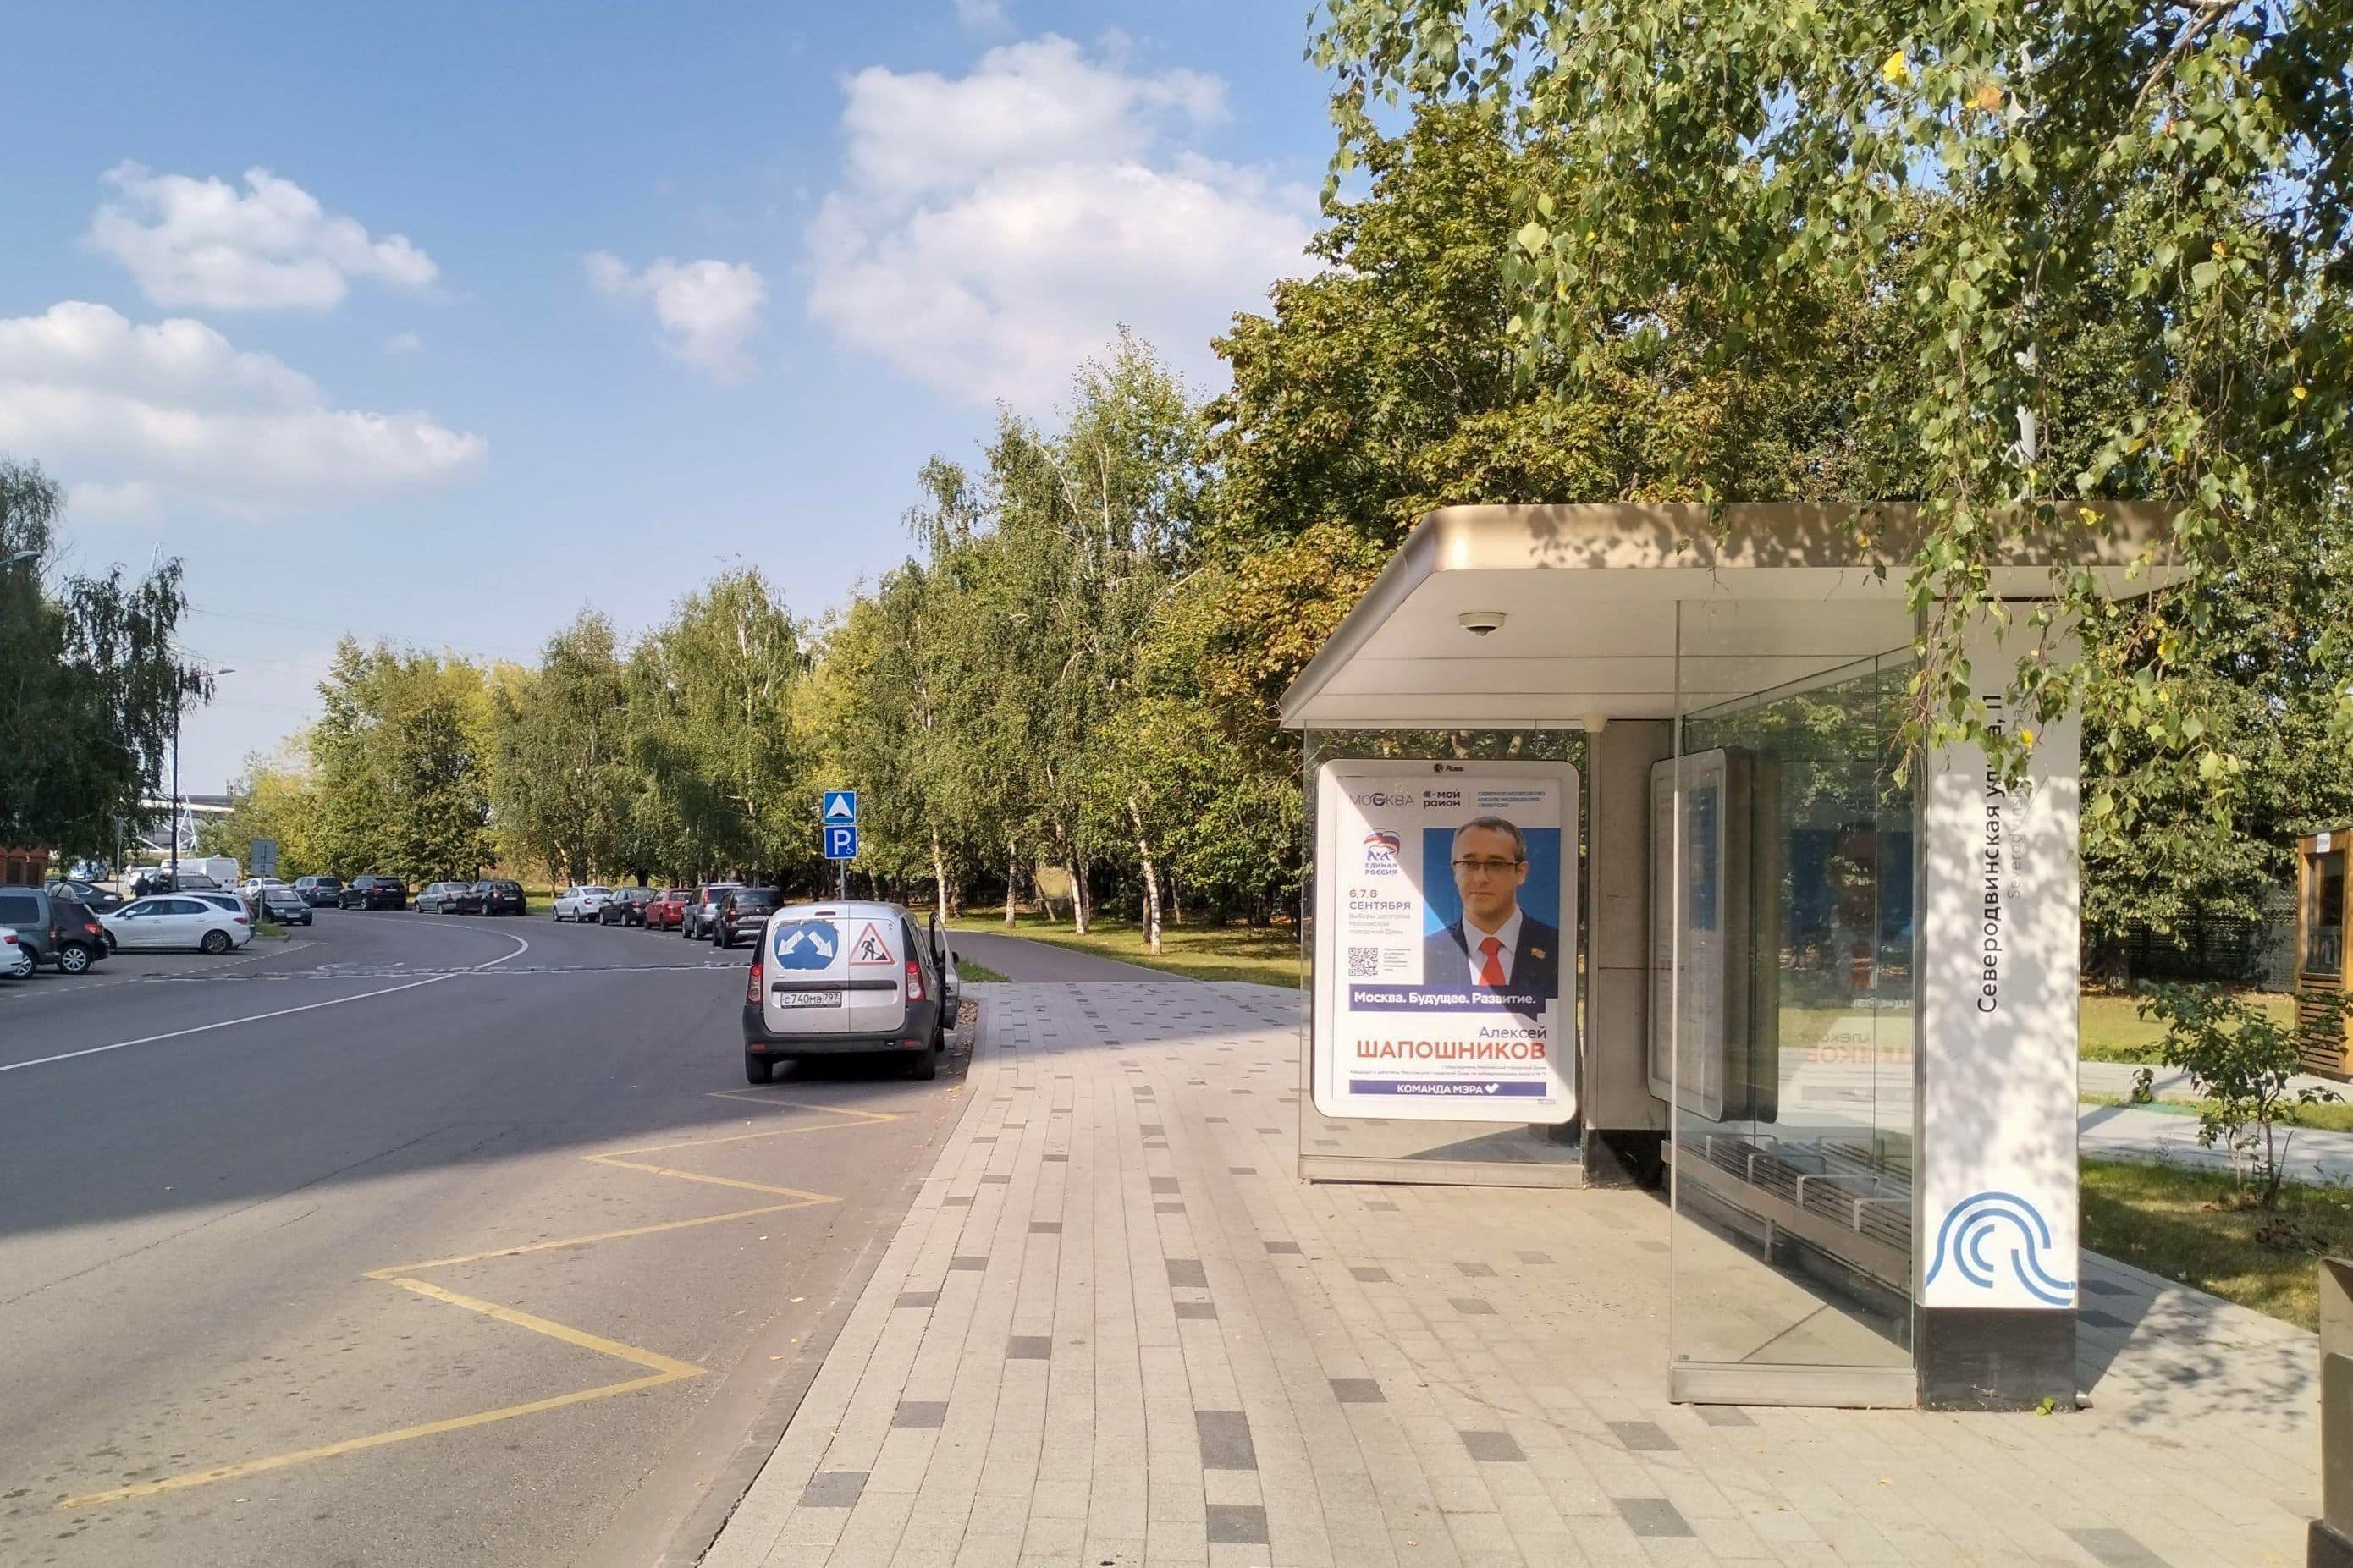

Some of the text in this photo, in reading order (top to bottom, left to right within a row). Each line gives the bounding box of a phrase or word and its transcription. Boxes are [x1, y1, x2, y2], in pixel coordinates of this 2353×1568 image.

[1348, 792, 1414, 806] МОСКВА
[1436, 789, 1461, 799] мой
[834, 830, 851, 855] P
[1349, 901, 1411, 910] СЕНТЯБРЯ
[1977, 806, 2003, 1014] Северодвинская
[1353, 991, 1536, 1006] Москва. Будущее. Развитие.
[1478, 1026, 1547, 1040] Алексей
[1356, 1040, 1546, 1060] ШАПОШНИКОВ
[1397, 1083, 1485, 1095] КОМАНДА МЭРА
